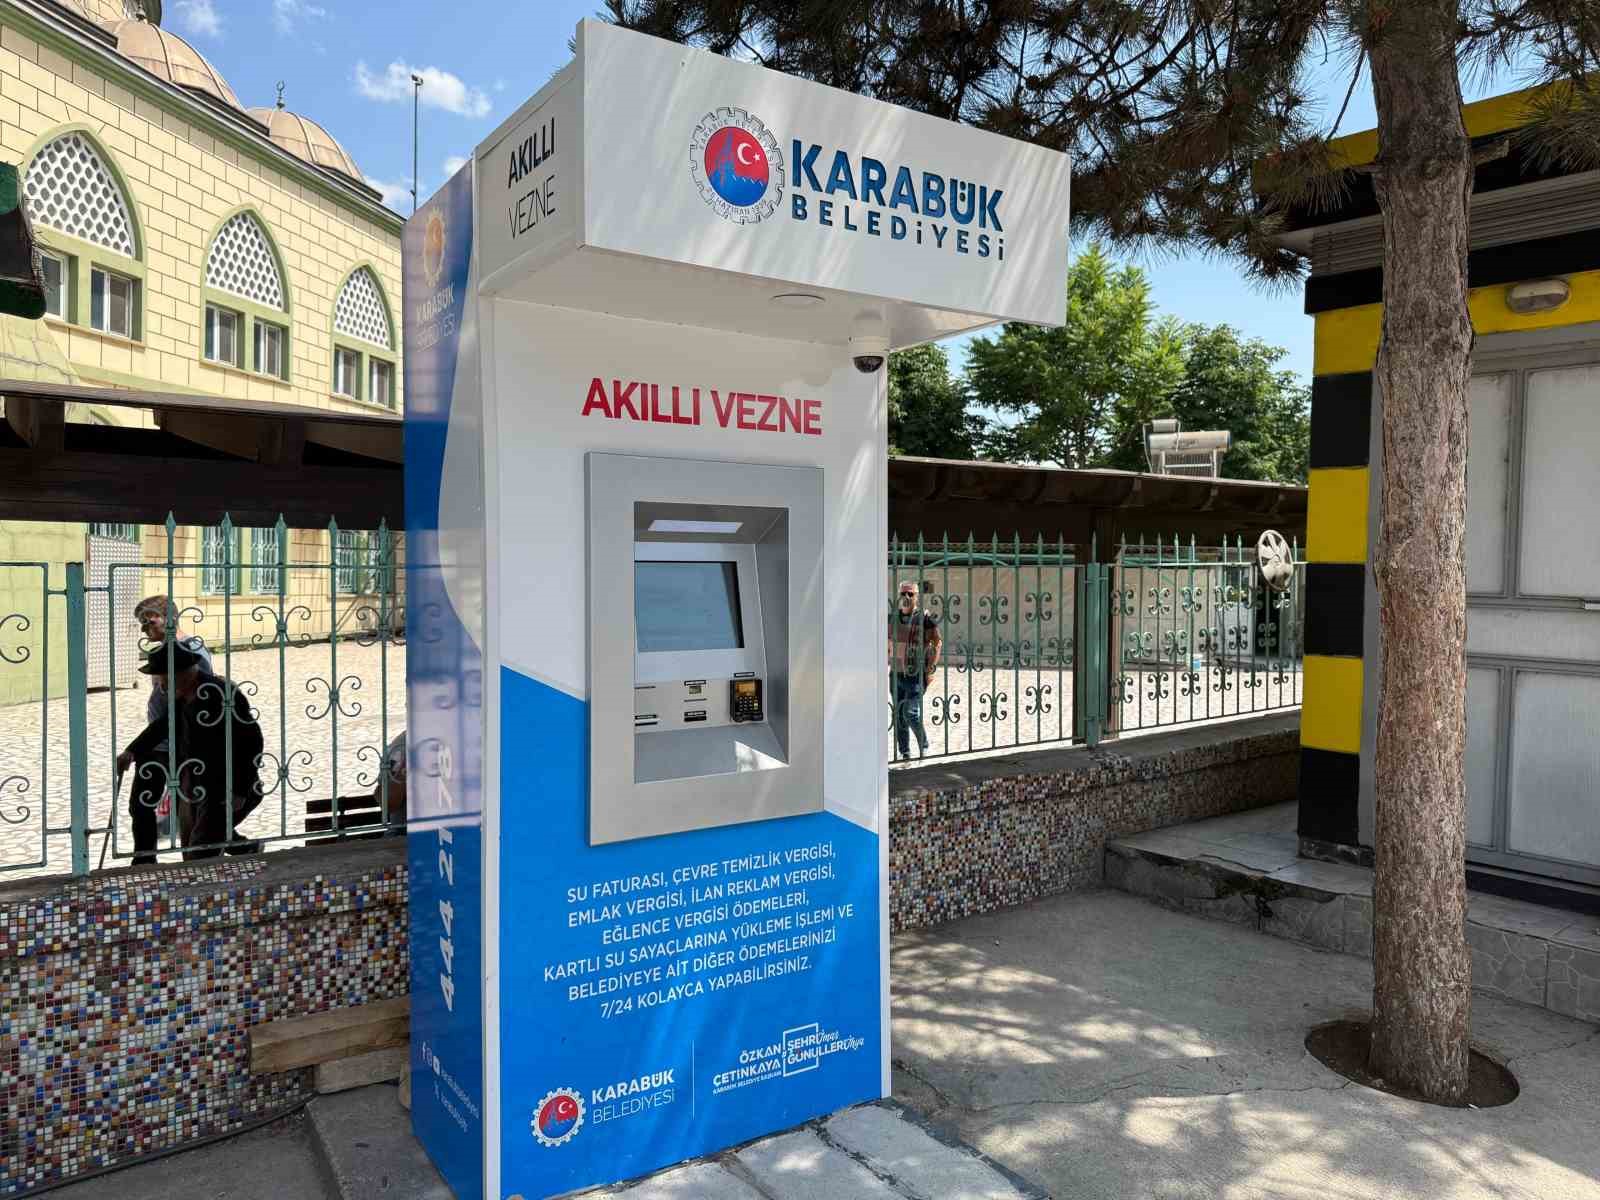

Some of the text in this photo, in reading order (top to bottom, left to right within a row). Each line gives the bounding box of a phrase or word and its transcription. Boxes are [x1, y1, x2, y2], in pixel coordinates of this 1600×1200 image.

[508, 117, 555, 189] AKILLI
[508, 174, 556, 239] VEZNE
[791, 139, 1004, 233] KARABÜK
[581, 377, 823, 436] AKILLI VEZNE
[438, 826, 453, 886] 21
[567, 840, 837, 904] SU FATURASI, ÇEVRE TEMİZLİK VERGİSİ,
[568, 862, 836, 928] EMLAK VERGİSİ, İLAN REKLAM VERGİSİ,
[602, 888, 809, 946] EĞLENCE VERGİSİ ÖDEMELERİ,
[439, 899, 454, 1012] 444
[544, 903, 854, 983] KARTLI SU SAYAÇLARINA YÜKLEME İŞLEMİ VE
[568, 925, 837, 1002] BELEDİYEYE AİT DİĞER ÖDEMELERİNİZİ
[600, 954, 812, 1019] 7/24 KOLAYCA YAPABİLİRSİNİZ.
[712, 1058, 782, 1087] ÇETİNKAYA
[739, 1042, 782, 1065] ÖZKAN
[591, 1068, 675, 1105] KARABÜK
[592, 1089, 675, 1125] BELEDİYESİ
